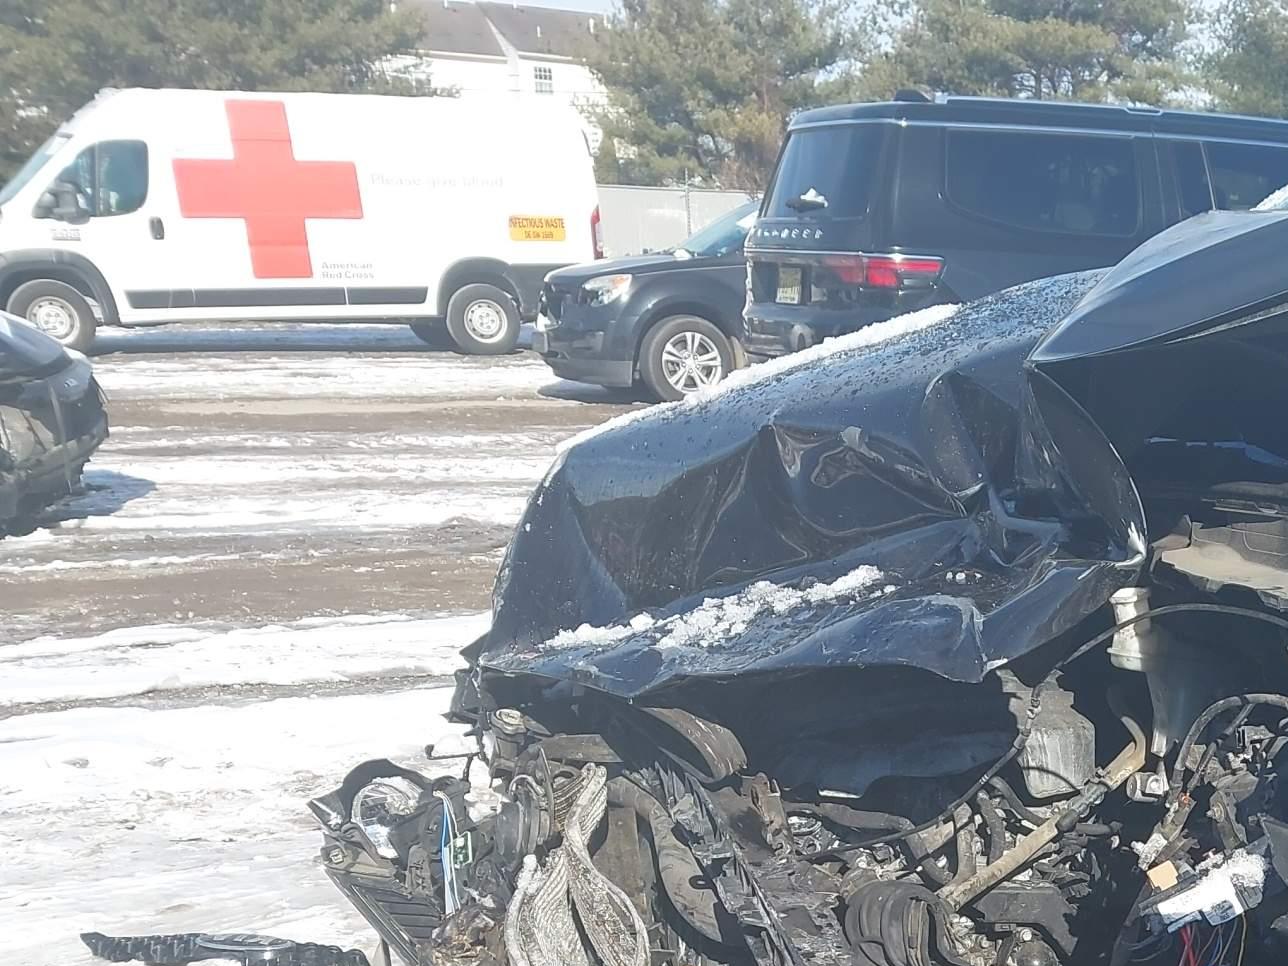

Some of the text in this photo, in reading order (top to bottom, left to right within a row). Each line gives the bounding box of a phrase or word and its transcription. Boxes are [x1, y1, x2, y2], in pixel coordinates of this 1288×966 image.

[545, 217, 564, 229] WASTE
[321, 261, 373, 269] American
[321, 270, 342, 279] Red
